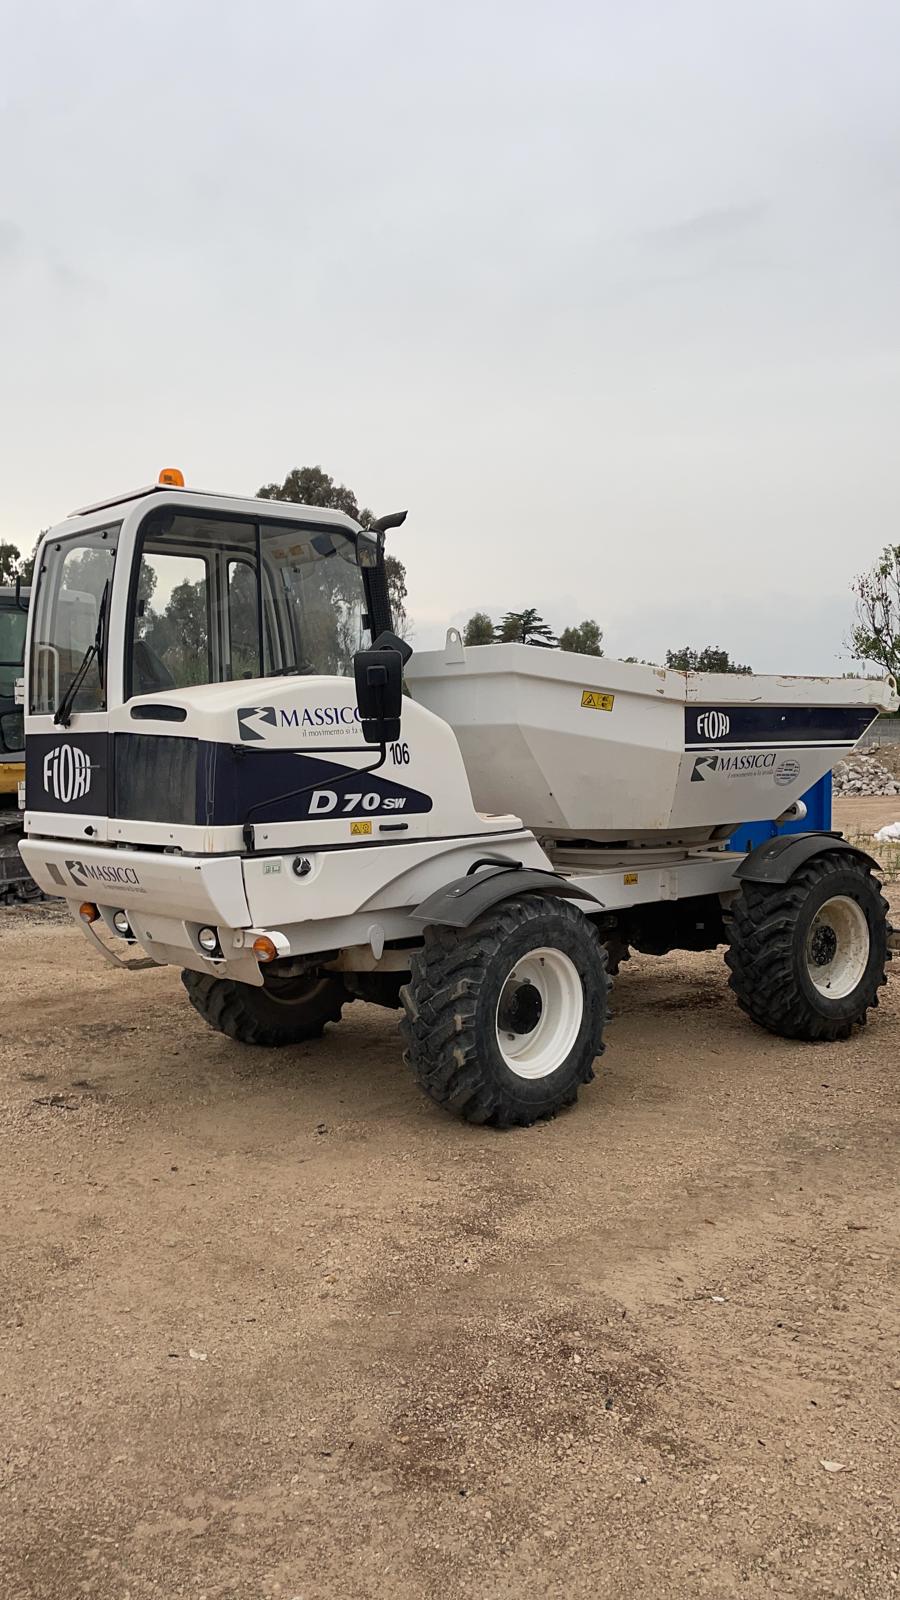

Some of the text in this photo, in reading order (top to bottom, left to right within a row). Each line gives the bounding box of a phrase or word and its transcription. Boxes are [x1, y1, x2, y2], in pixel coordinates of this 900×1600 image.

[280, 706, 362, 727] MASSICC
[389, 743, 410, 765] 106
[718, 753, 777, 771] MASSICCI
[308, 790, 338, 814] D
[342, 793, 381, 812] 70
[84, 864, 140, 884] MASSICCI
